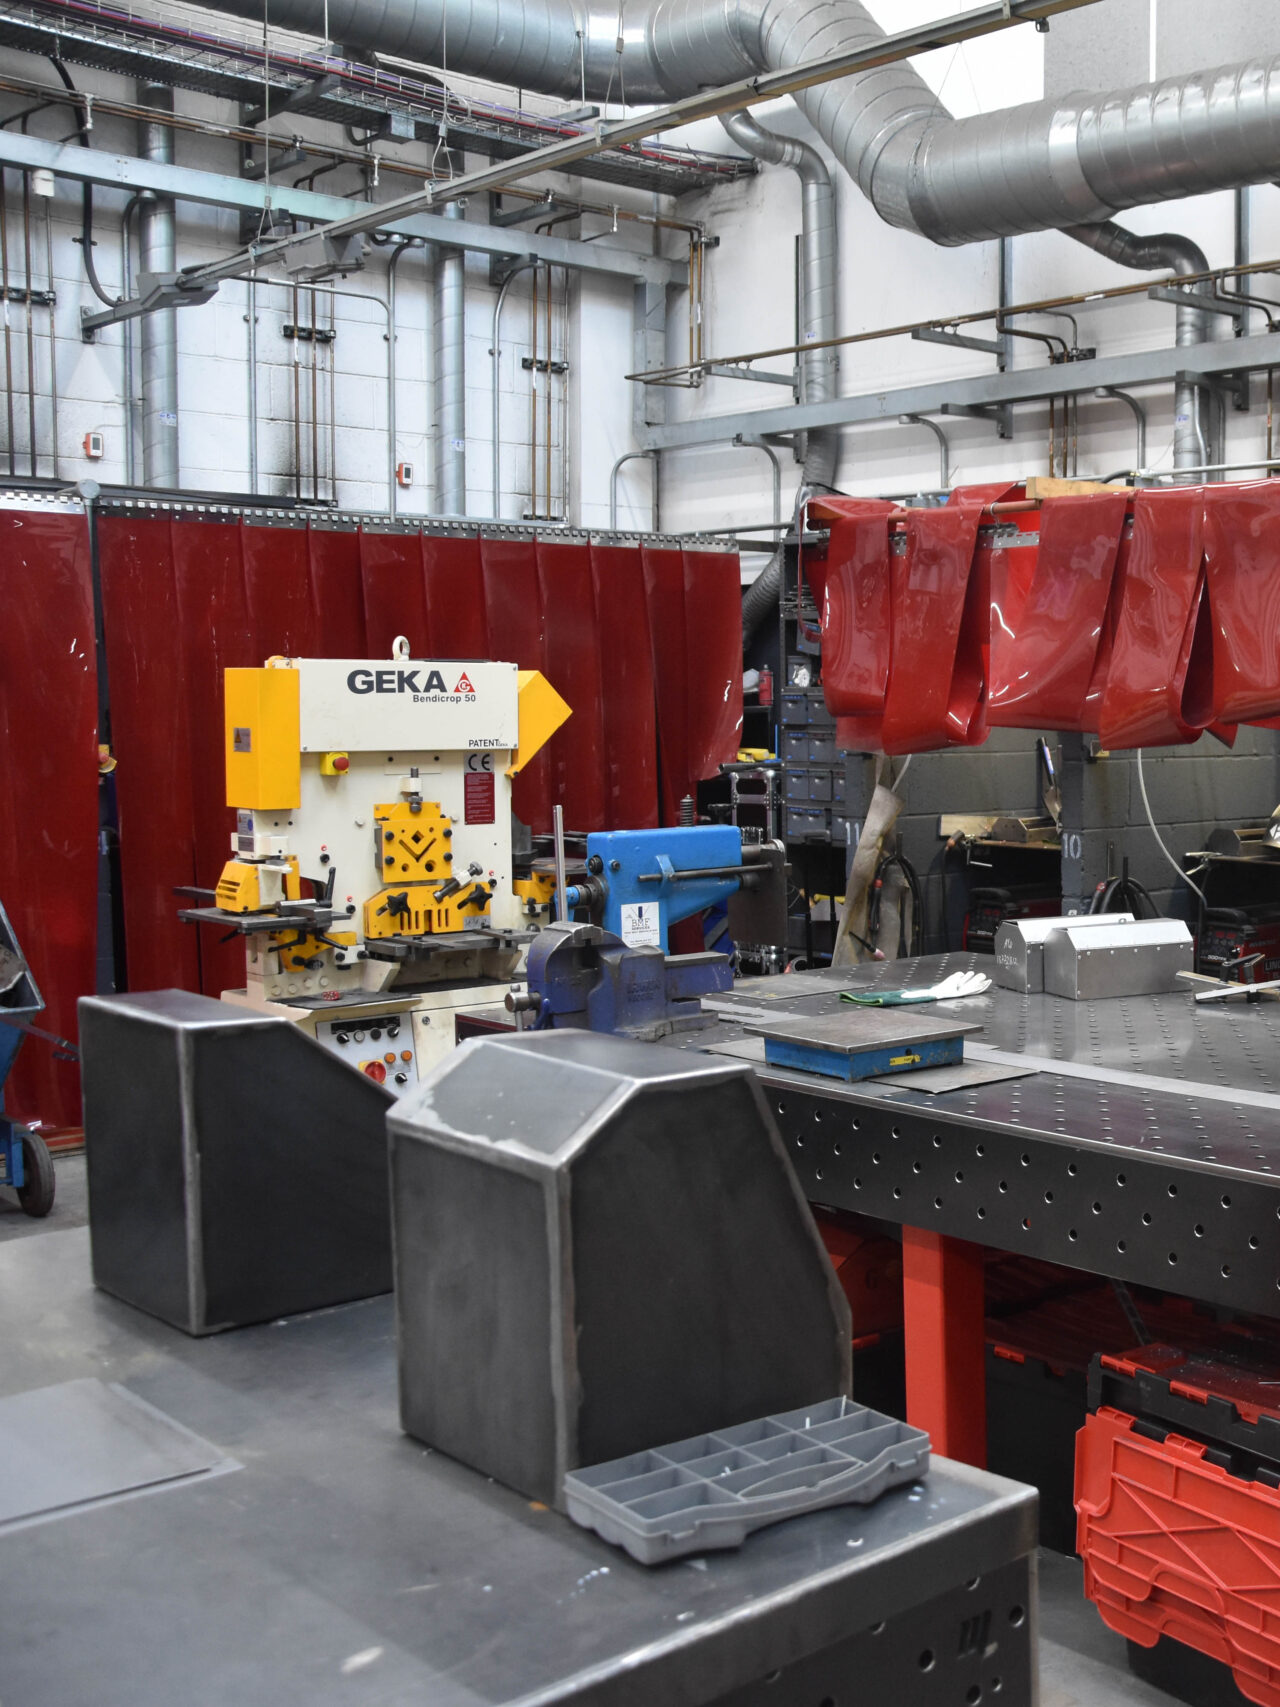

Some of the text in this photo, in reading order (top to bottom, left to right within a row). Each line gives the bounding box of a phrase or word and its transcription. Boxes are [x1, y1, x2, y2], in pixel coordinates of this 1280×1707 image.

[347, 669, 447, 694] GEKA
[413, 694, 476, 703] Bendicrop 50
[468, 739, 499, 747] PATENT
[845, 822, 860, 846] 11
[1062, 832, 1081, 859] 10
